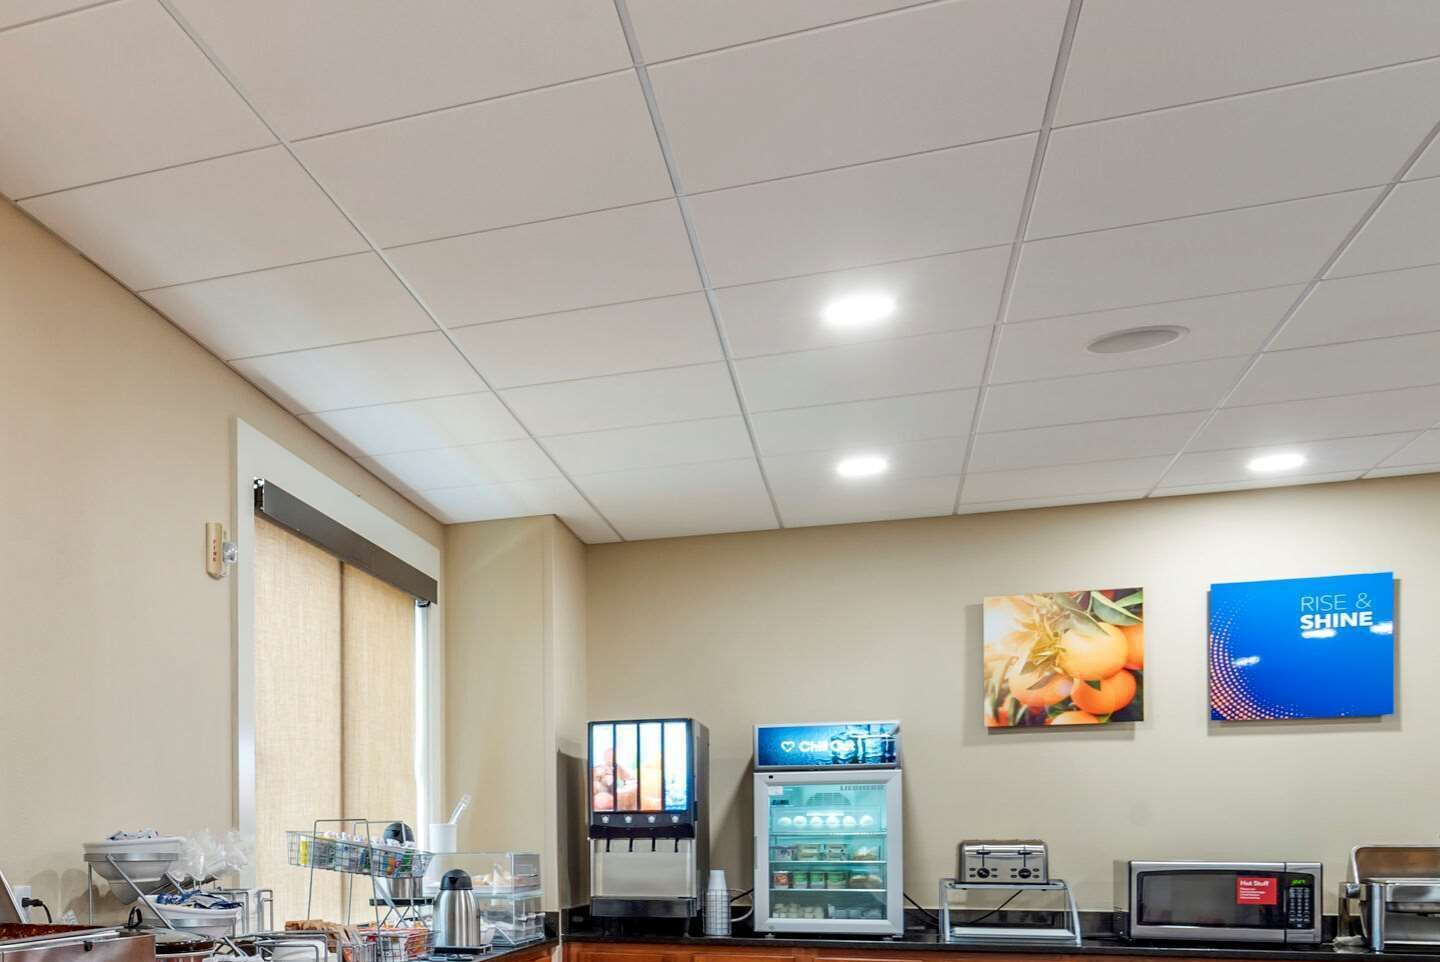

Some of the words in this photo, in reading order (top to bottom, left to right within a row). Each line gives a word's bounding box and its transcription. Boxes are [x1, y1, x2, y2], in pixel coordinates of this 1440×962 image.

[1301, 594, 1348, 612] RISE
[1355, 592, 1372, 609] &
[1300, 611, 1374, 630] SHINE
